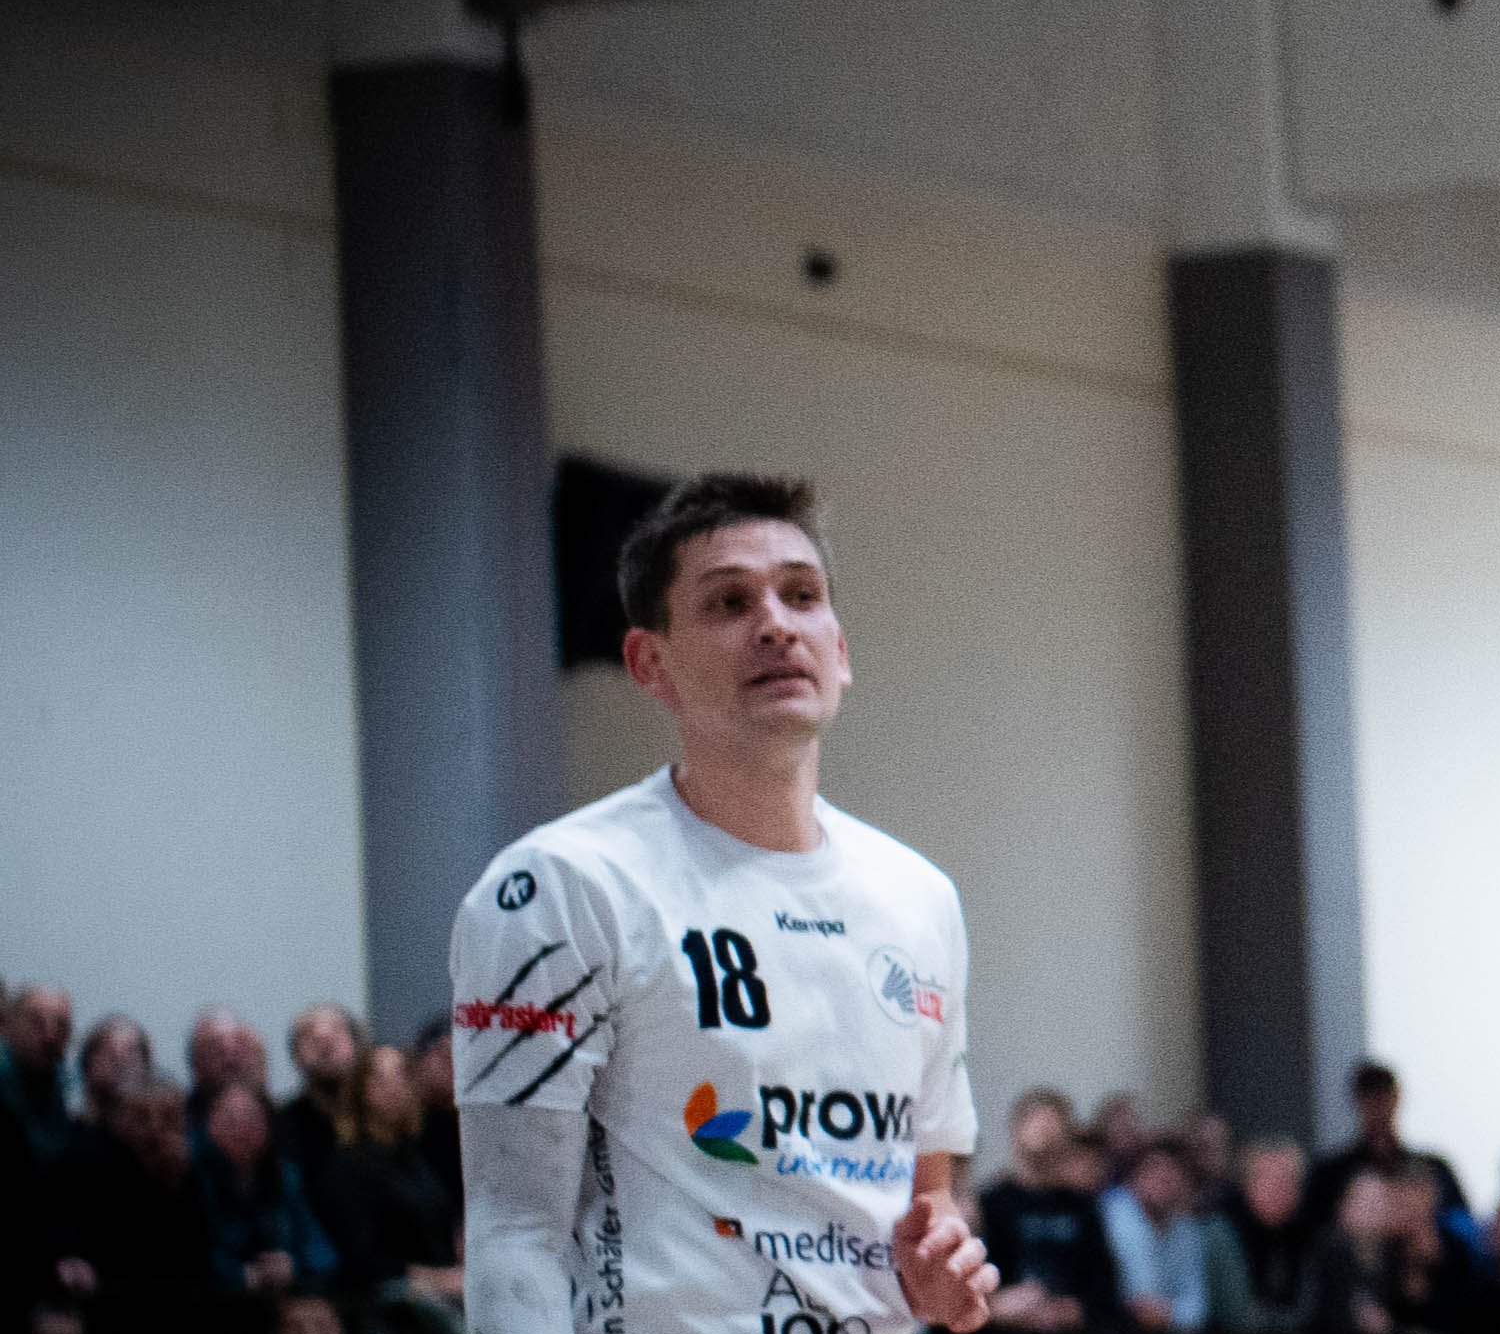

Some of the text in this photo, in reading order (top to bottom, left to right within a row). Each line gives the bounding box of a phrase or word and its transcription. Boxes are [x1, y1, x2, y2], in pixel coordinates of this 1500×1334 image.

[775, 910, 847, 938] Kempa
[681, 927, 771, 1030] 18
[595, 1204, 624, 1309] Schäfer
